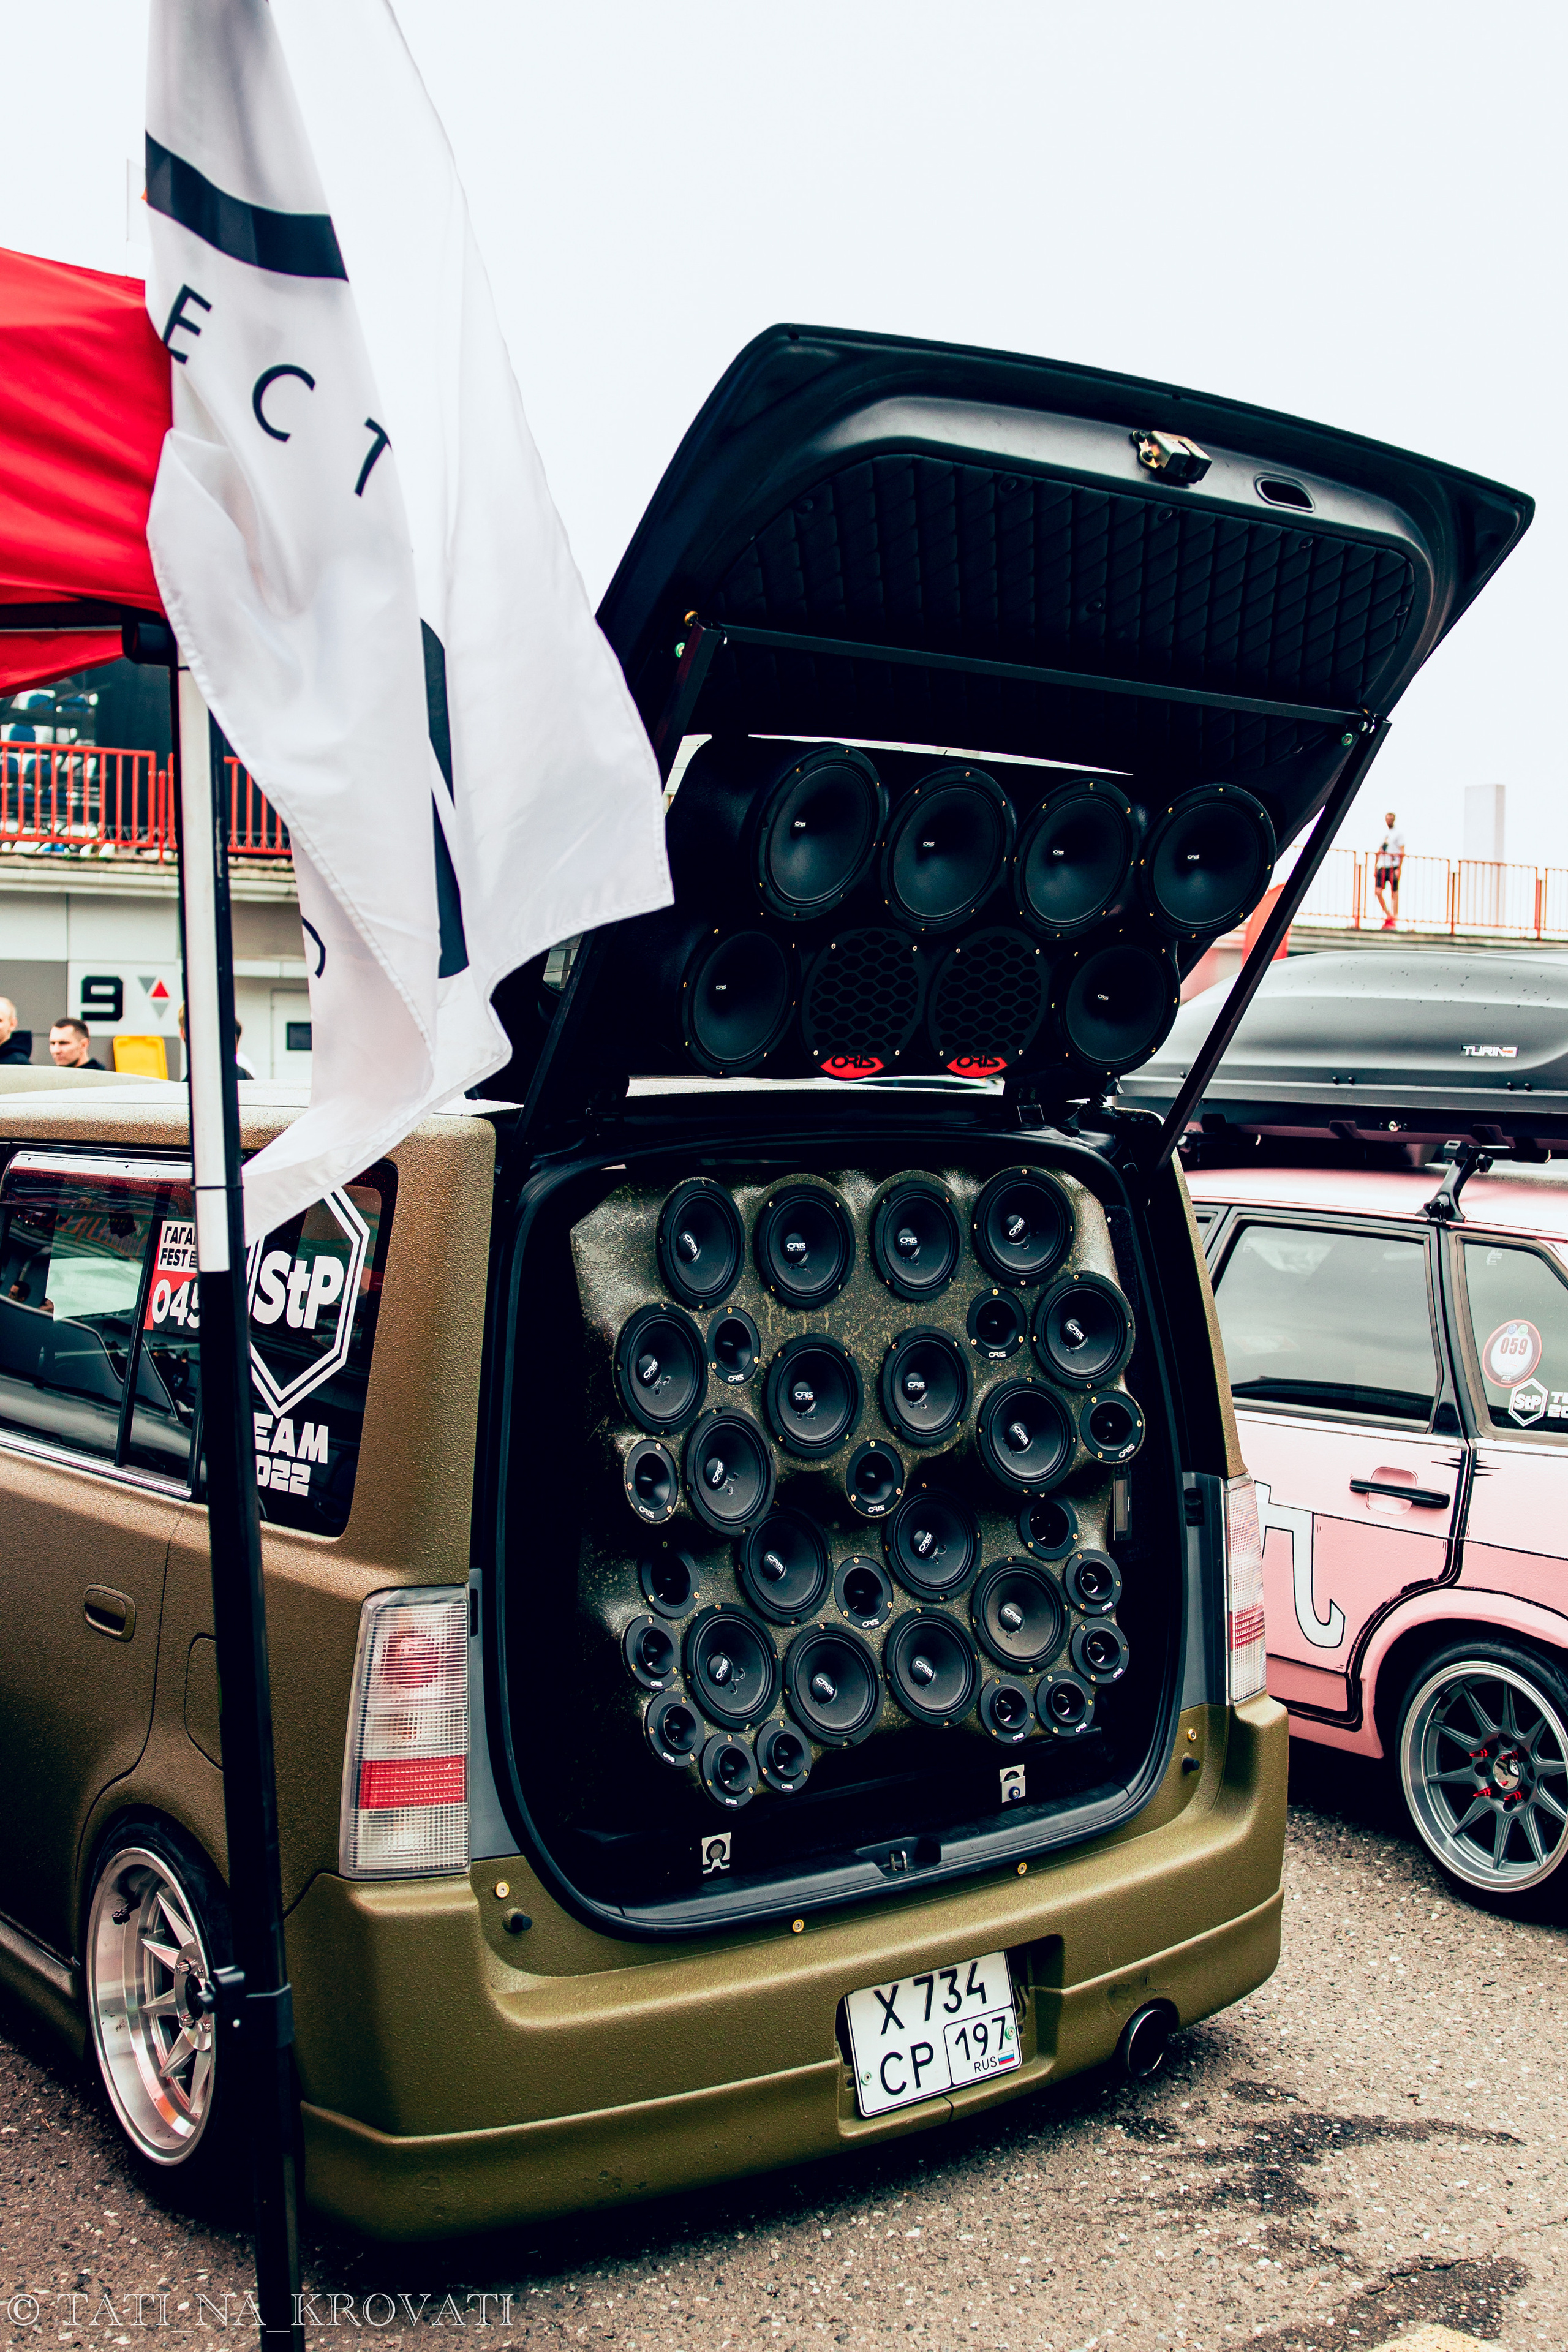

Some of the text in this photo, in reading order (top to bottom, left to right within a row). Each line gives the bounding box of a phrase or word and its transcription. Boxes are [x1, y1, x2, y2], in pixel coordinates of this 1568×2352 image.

[81, 976, 124, 1022] 9
[831, 1055, 876, 1069] ORIS
[957, 1055, 1000, 1068] ORIS
[1009, 1217, 1024, 1236] ORIS
[684, 1234, 698, 1254] ORIS
[160, 1248, 189, 1267] FEST
[252, 1250, 344, 1330] StP
[1068, 1322, 1084, 1340] ORIS
[1500, 1336, 1528, 1355] 059
[643, 1359, 658, 1378] ORIS
[728, 1373, 744, 1382] ORIS
[1514, 1393, 1542, 1411] StP
[254, 1412, 328, 1464] EAM
[1014, 1425, 1030, 1445] ORIS
[1118, 1443, 1135, 1458] ORIS
[255, 1454, 311, 1497] 022
[639, 1505, 654, 1518] ORIS
[868, 1504, 885, 1513] ORIS
[919, 1532, 932, 1552] ORIS
[767, 1554, 784, 1572] ORIS
[862, 1618, 879, 1628] ORIS
[1005, 1607, 1022, 1624] ORIS
[716, 1658, 728, 1679] ORIS
[916, 1660, 933, 1676] ORIS
[816, 1677, 834, 1695] ORIS
[913, 1961, 987, 2022] 734
[954, 2015, 1006, 2061] 197
[974, 2056, 997, 2073] RUS
